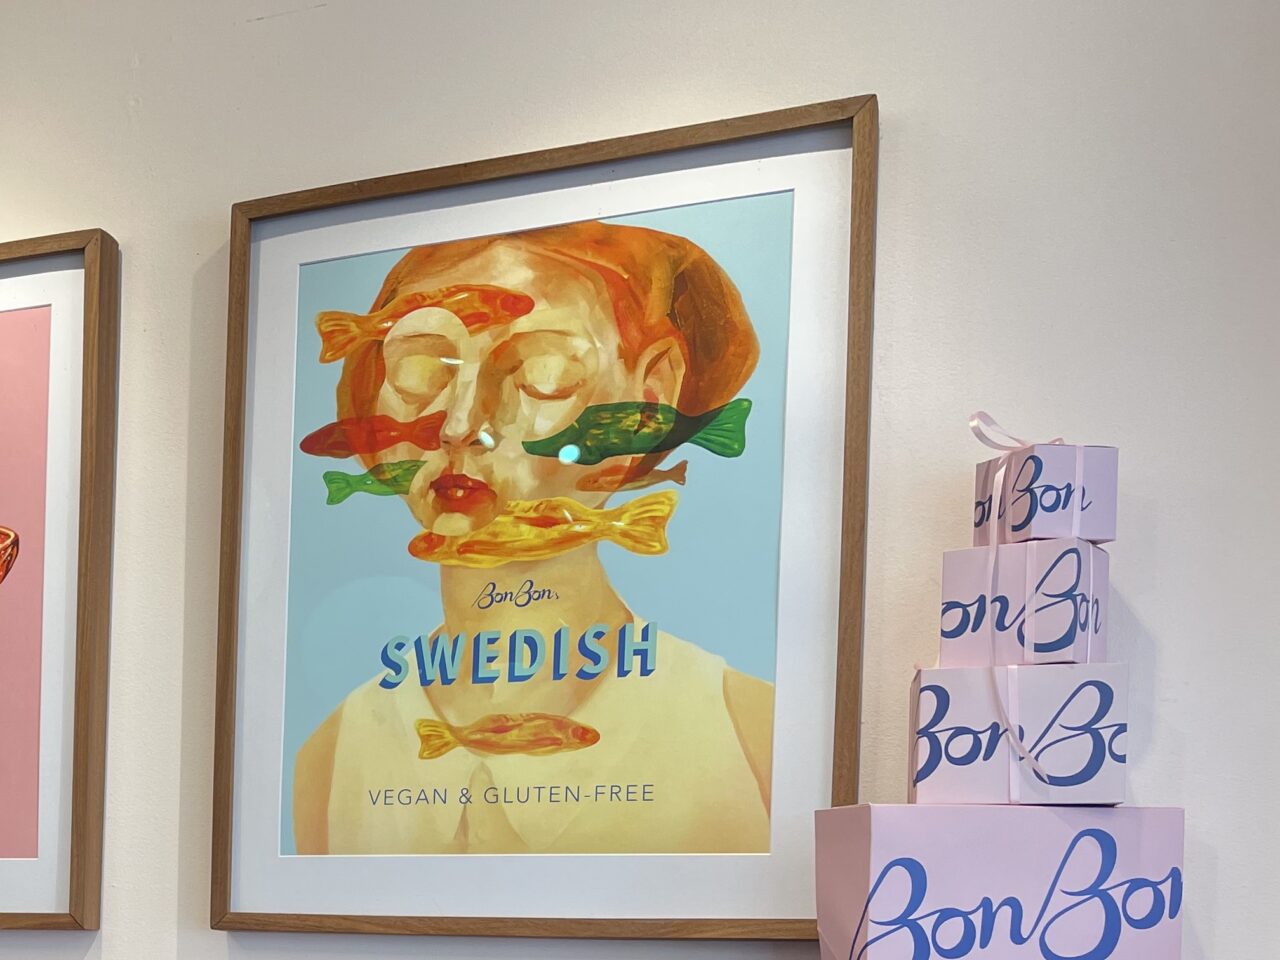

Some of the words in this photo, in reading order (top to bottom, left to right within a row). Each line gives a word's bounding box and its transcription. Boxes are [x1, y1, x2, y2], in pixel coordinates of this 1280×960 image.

[974, 454, 1092, 532] onBon
[941, 547, 1100, 653] onBon
[378, 621, 658, 689] SWEDISH
[369, 788, 447, 806] VEGAN
[458, 787, 472, 804] &
[483, 784, 654, 804] GLUTEN-FREE
